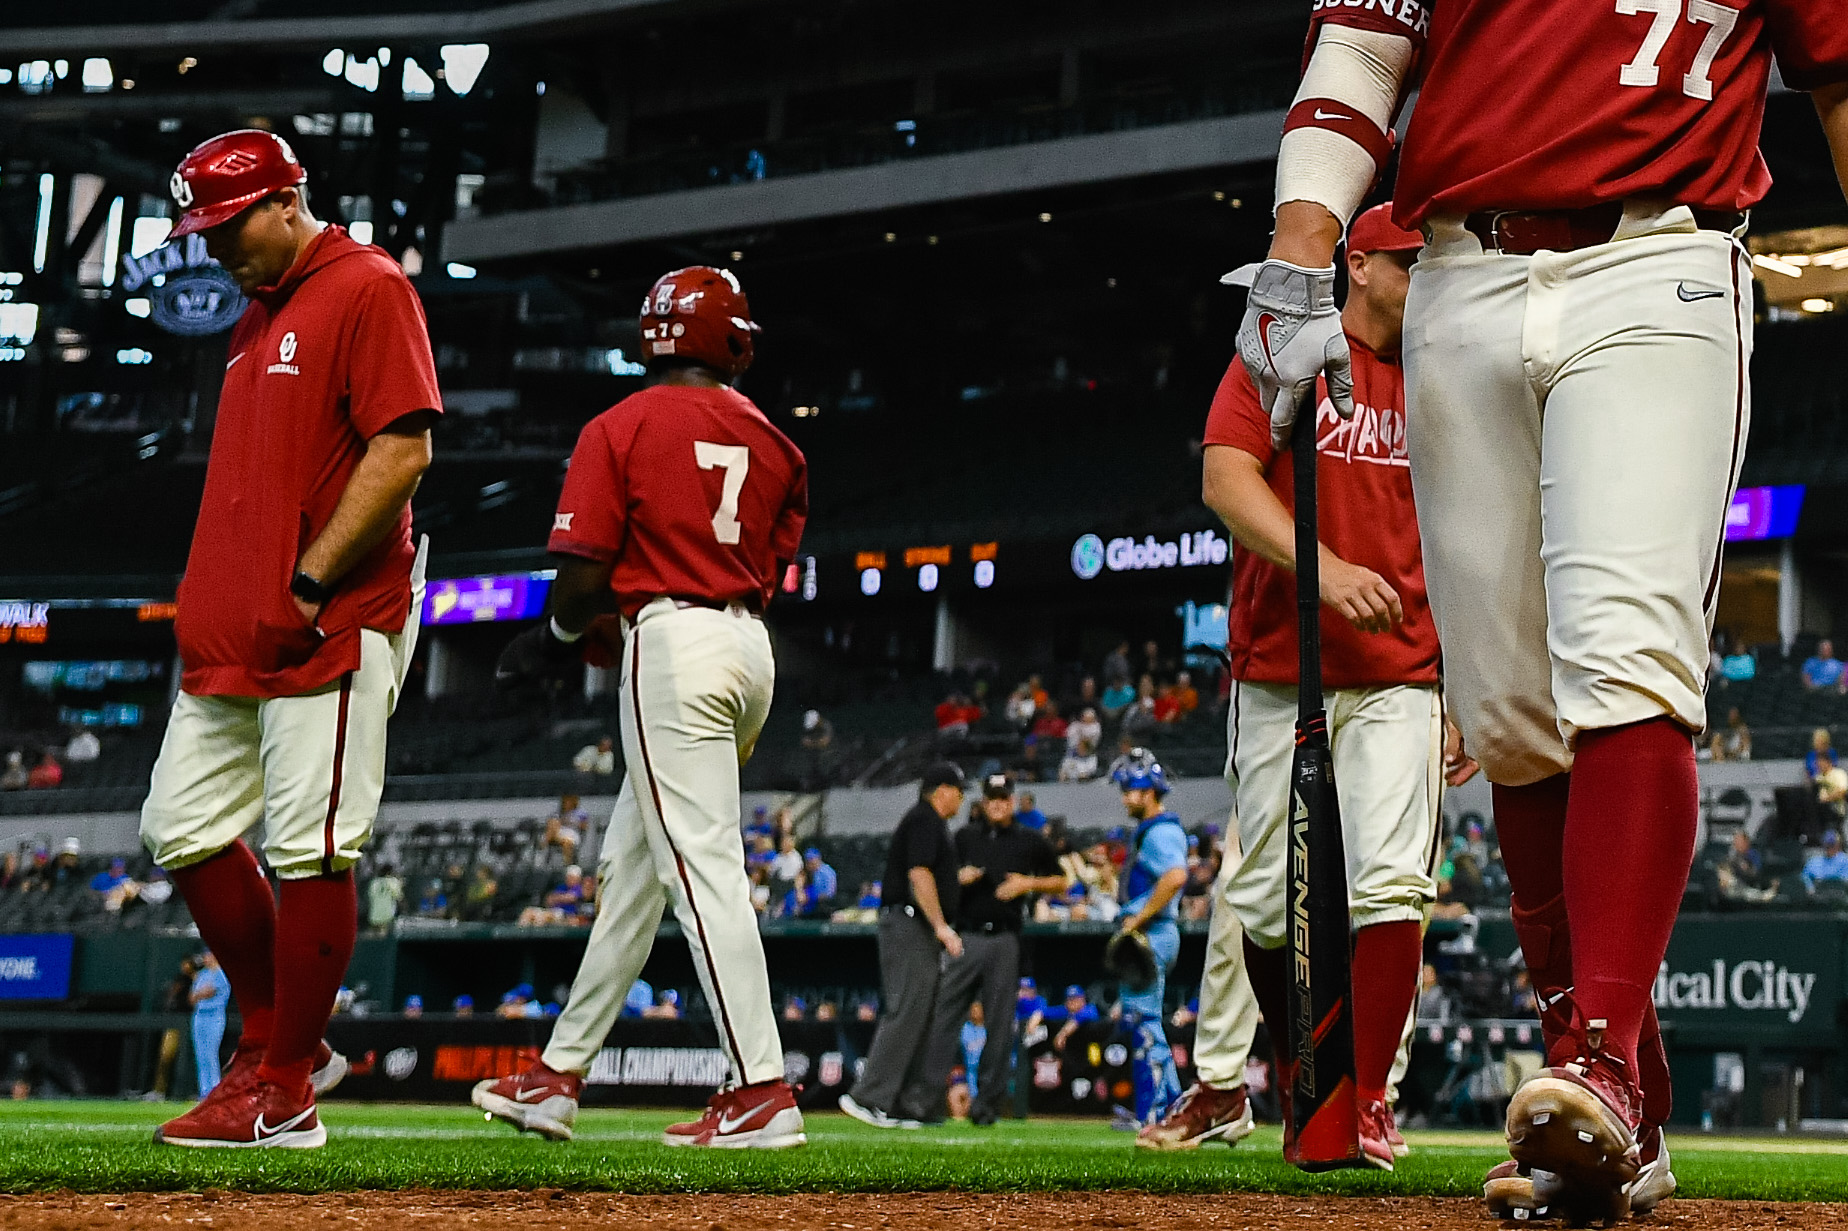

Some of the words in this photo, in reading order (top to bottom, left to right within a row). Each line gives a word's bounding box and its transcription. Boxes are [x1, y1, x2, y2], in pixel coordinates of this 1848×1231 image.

[693, 440, 750, 546] 7
[1105, 535, 1179, 571] Globe
[1180, 529, 1228, 566] Life
[1729, 960, 1817, 1022] City
